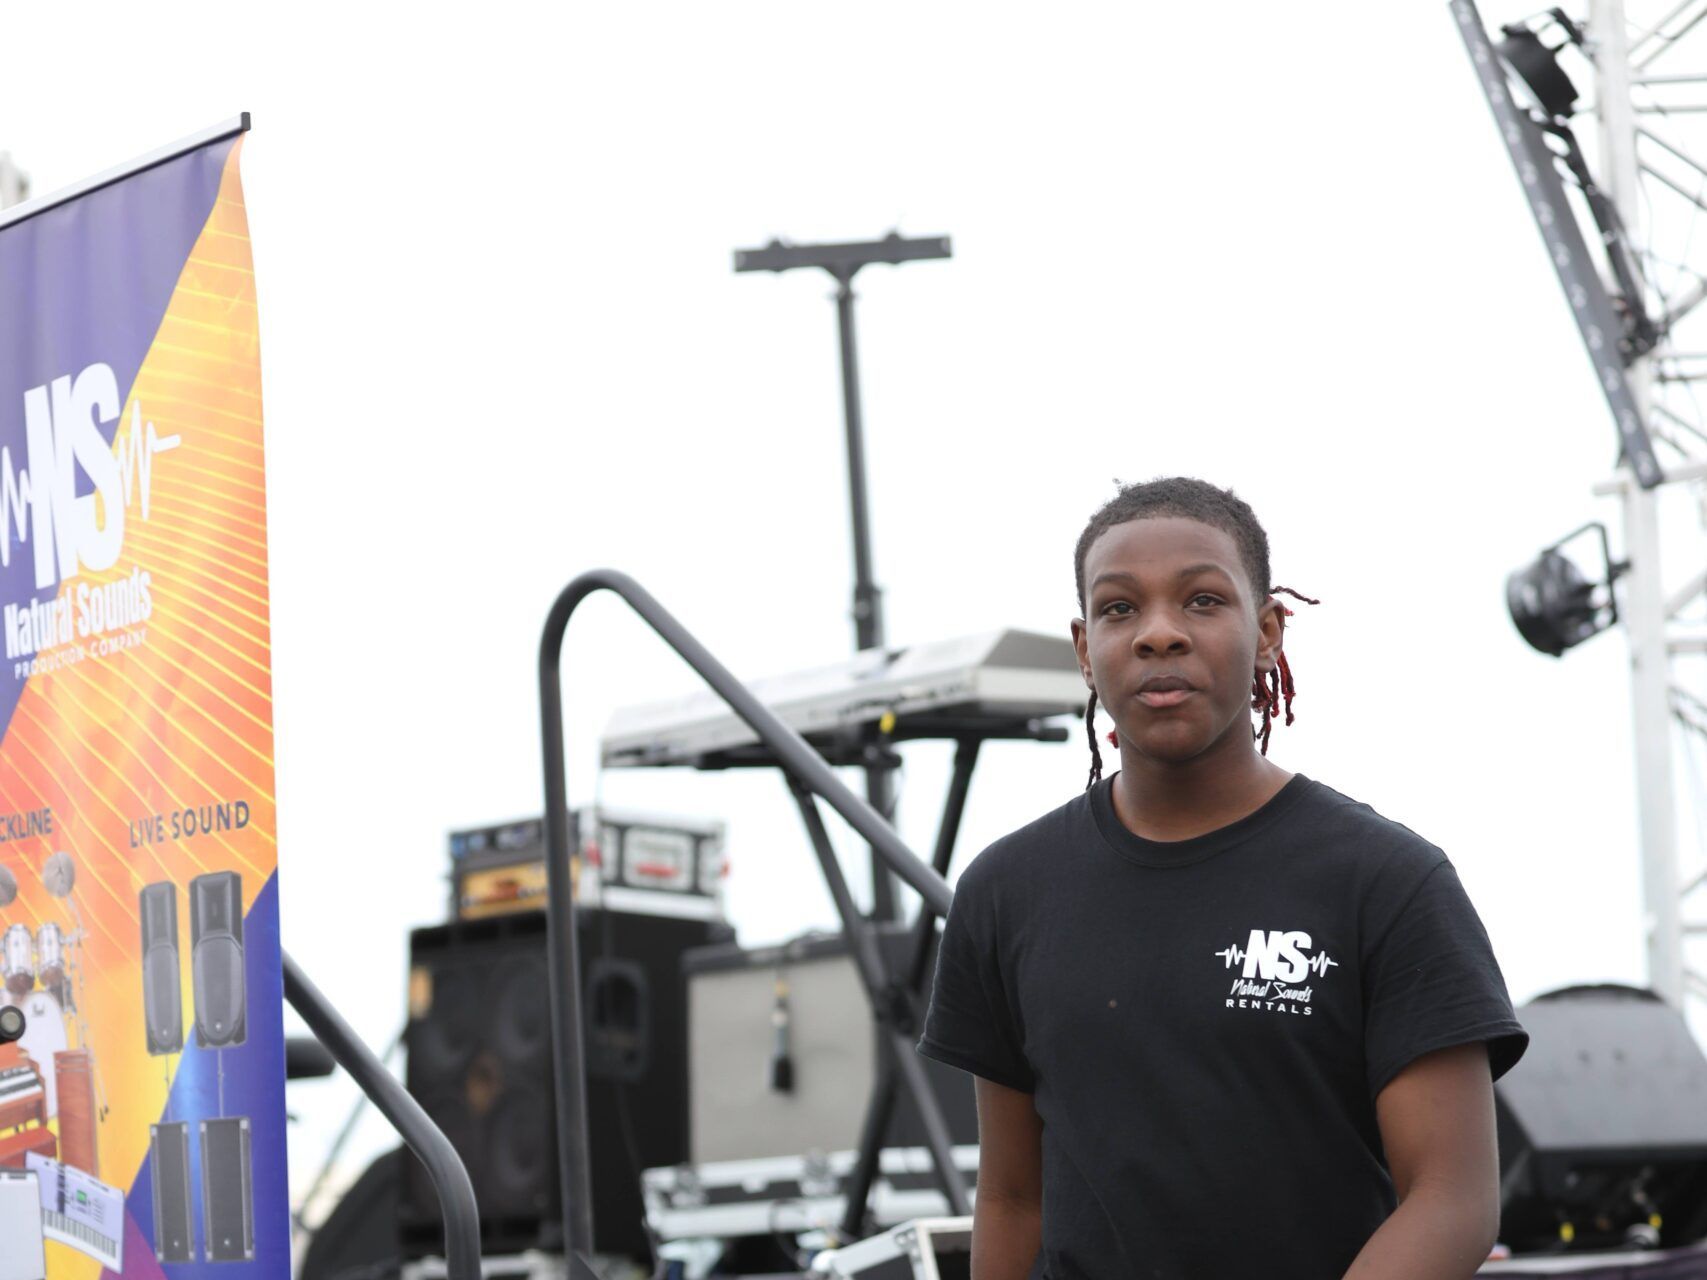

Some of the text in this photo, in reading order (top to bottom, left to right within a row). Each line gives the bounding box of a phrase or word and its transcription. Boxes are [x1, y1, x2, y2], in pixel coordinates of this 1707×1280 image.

[24, 362, 124, 590] NS
[4, 566, 152, 659] Natural Sounds
[14, 630, 147, 680] PRODUCTION COMPANY
[129, 800, 250, 848] LIVE SOUND
[1242, 929, 1312, 983] NS
[1225, 998, 1312, 1016] RENTALS
[1268, 981, 1313, 1003] Sounds
